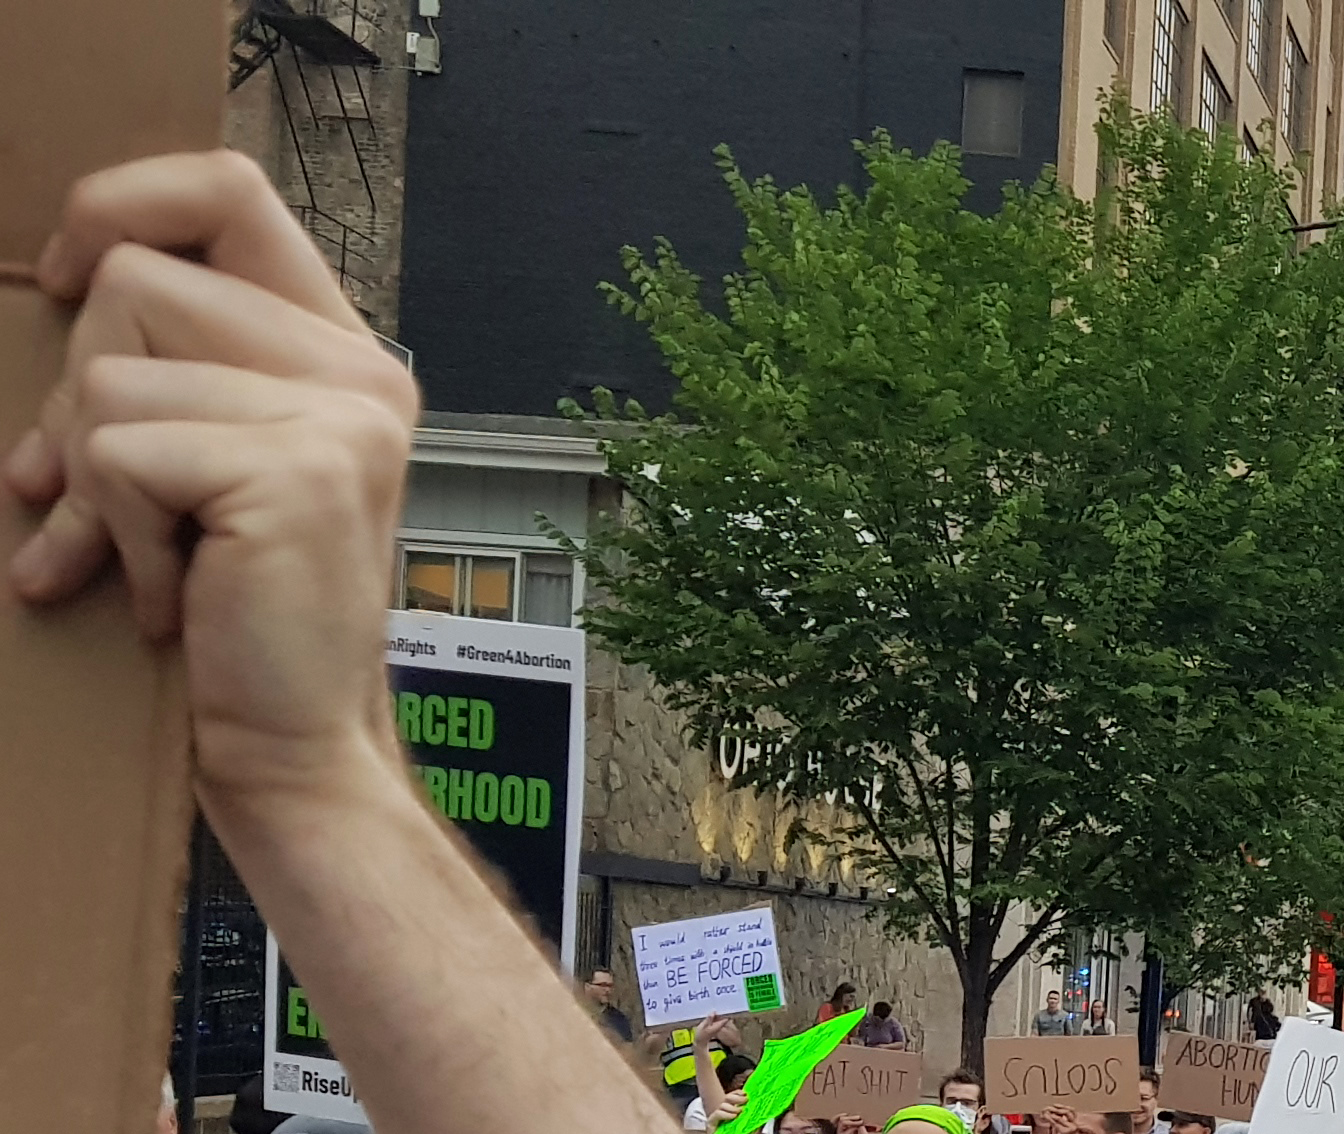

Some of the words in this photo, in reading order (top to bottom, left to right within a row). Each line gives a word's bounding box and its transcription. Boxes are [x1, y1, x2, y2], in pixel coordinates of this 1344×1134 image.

[387, 637, 436, 657] nRights
[456, 644, 572, 671] #Green4Abortion
[388, 691, 495, 750] RCED
[416, 764, 552, 829] RHOOD
[666, 966, 689, 988] BE
[698, 951, 763, 983] FORCED
[857, 1065, 908, 1095] SHIT
[1286, 1049, 1339, 1113] OUR
